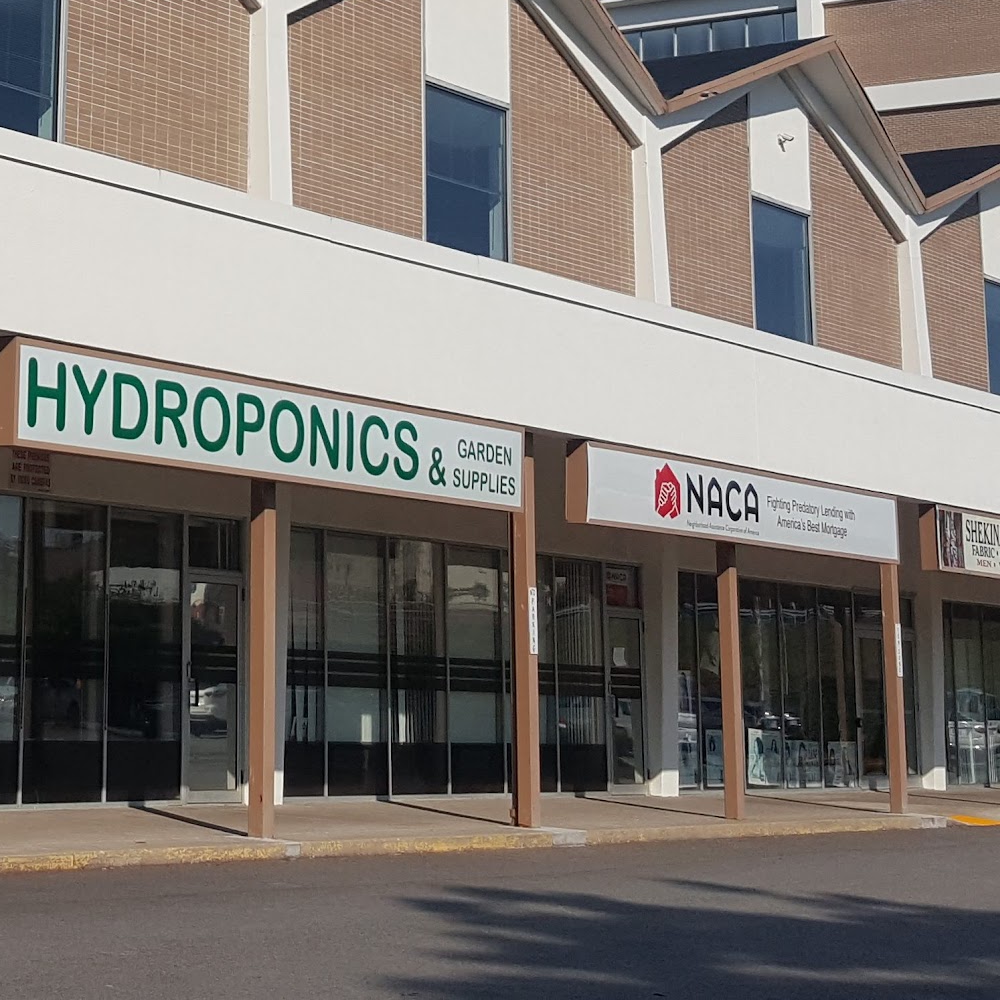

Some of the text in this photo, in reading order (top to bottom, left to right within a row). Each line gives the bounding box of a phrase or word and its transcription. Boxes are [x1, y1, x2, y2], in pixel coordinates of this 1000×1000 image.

[27, 356, 447, 487] HYDROPONICS &
[457, 438, 512, 467] GARDEN
[452, 467, 516, 496] SUPPLIES
[686, 472, 760, 524] NACA
[766, 495, 856, 522] Fighting Predatory Lending with
[776, 514, 848, 539] America's Best Mortgage
[971, 544, 996, 559] FABRIC
[976, 558, 992, 568] MEN
